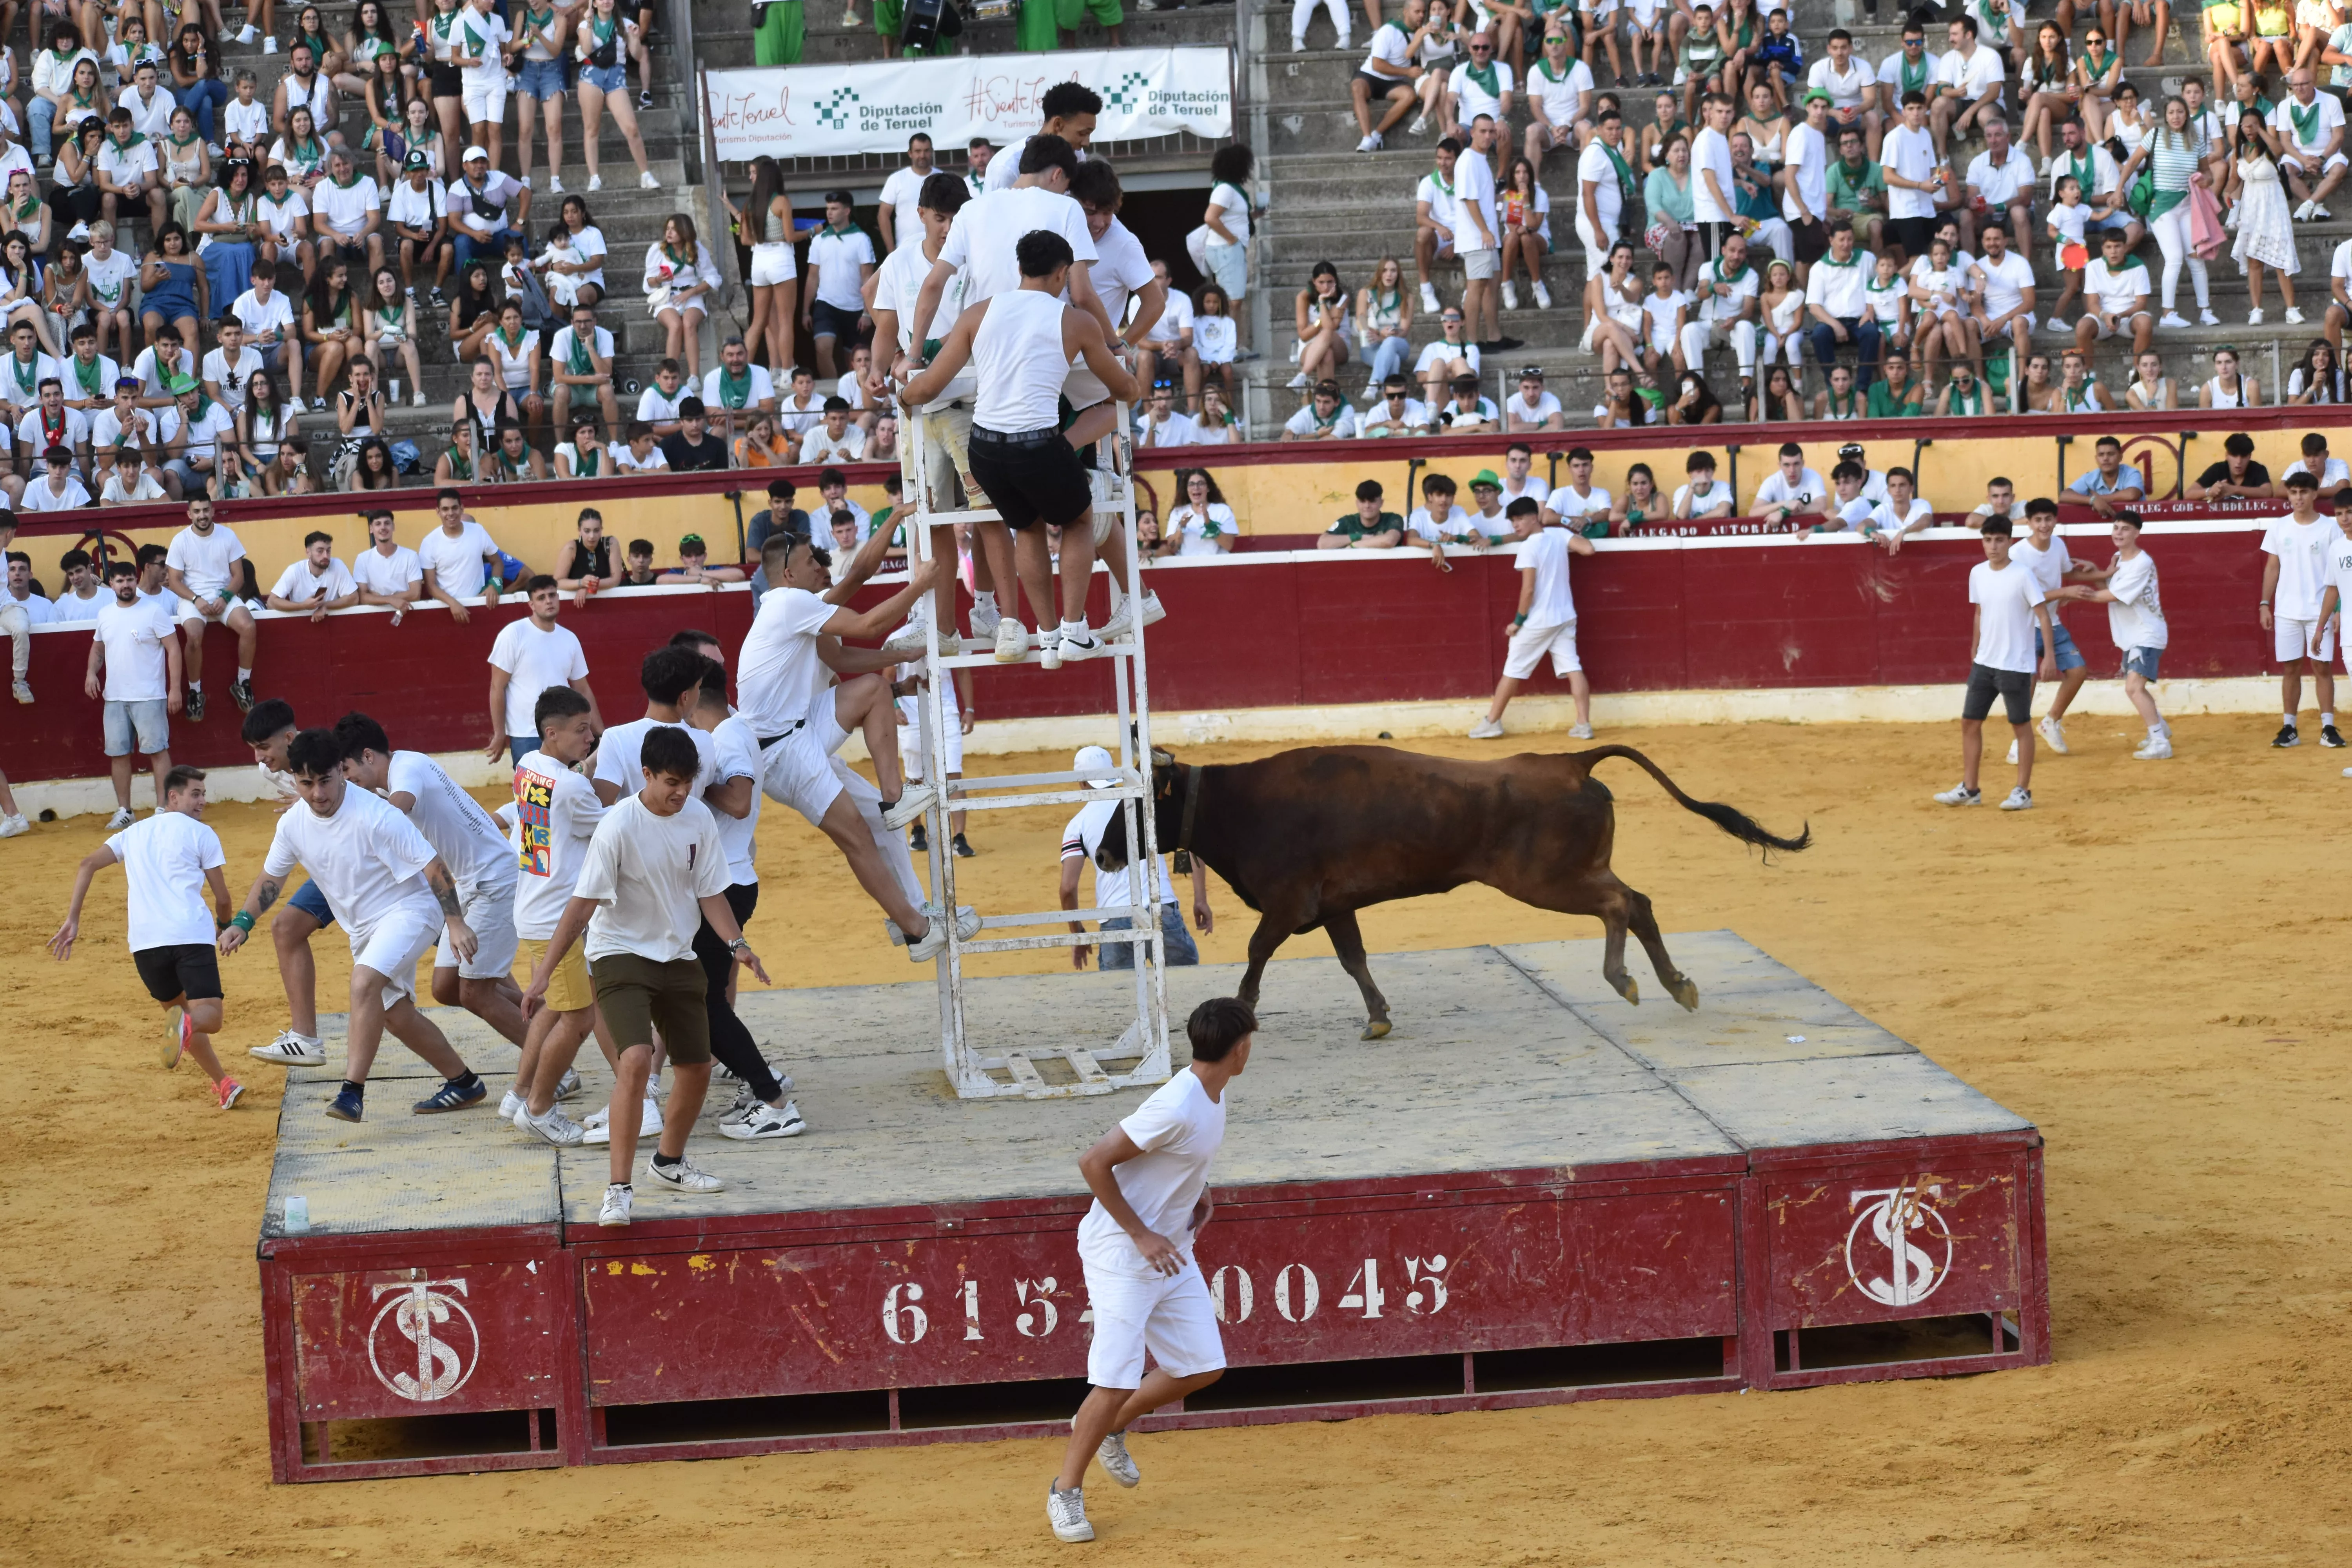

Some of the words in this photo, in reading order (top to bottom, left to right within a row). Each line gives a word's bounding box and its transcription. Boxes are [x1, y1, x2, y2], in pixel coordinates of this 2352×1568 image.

[1149, 89, 1229, 103] Diputación
[860, 102, 943, 118] Diputación
[1149, 103, 1166, 115] de
[1173, 103, 1218, 115] Teruel
[861, 119, 880, 131] de
[884, 117, 932, 130] Teruel
[1003, 120, 1036, 129] Turismo
[749, 133, 792, 143] Diputación
[2133, 450, 2153, 495] 1
[524, 769, 553, 788] SPRING
